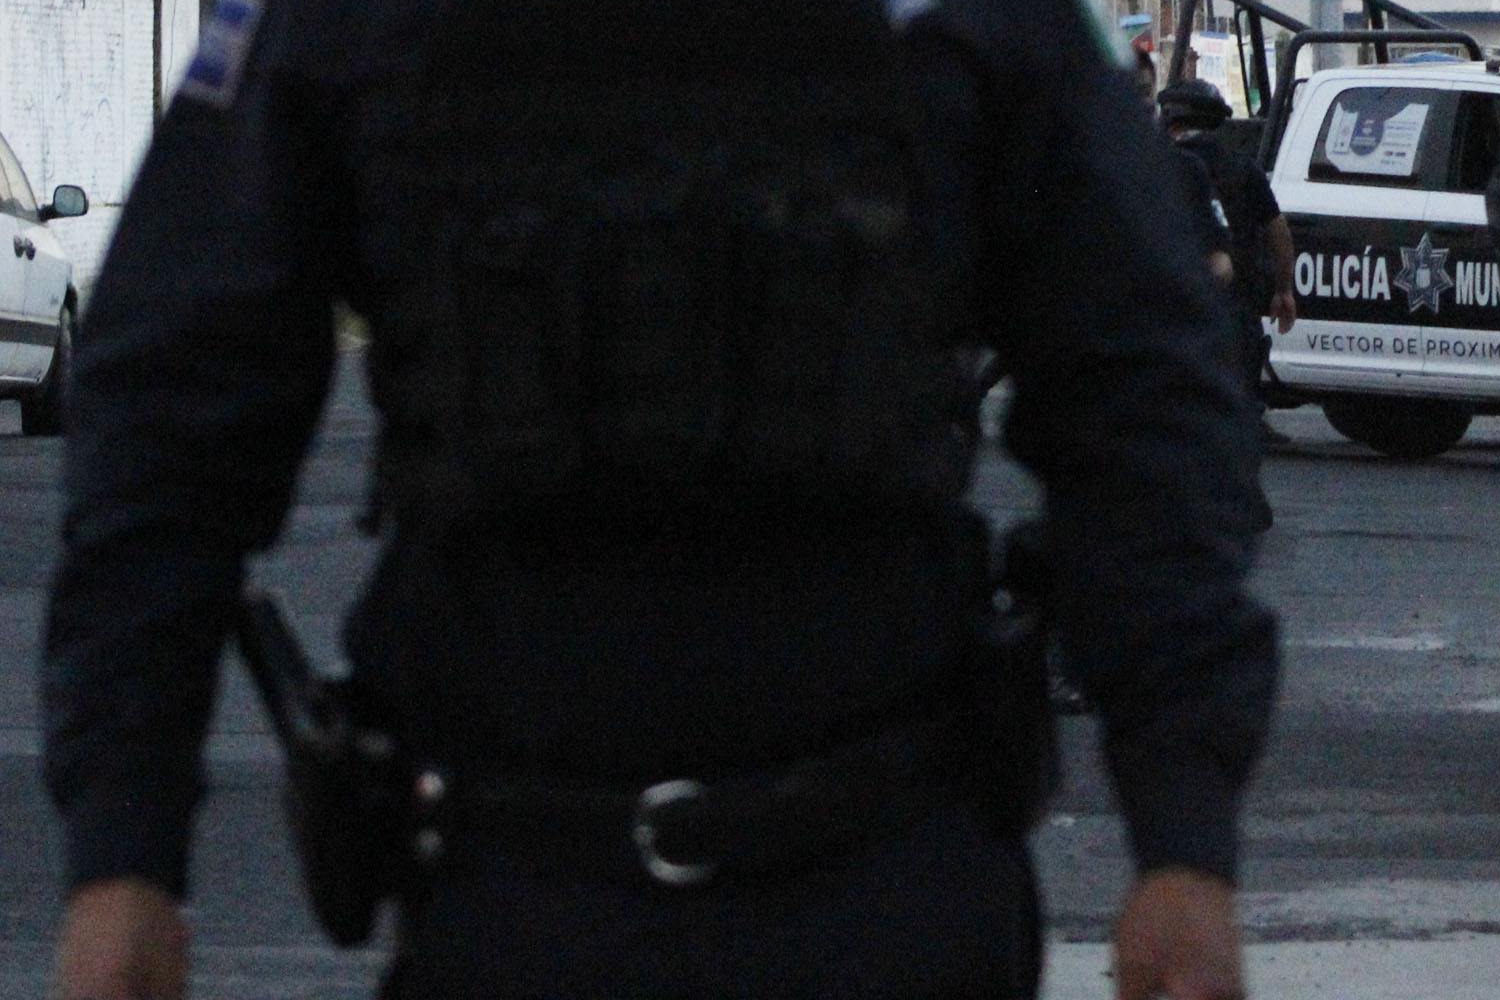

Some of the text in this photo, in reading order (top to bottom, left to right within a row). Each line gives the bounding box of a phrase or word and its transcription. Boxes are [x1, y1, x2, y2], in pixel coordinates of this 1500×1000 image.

[1294, 245, 1391, 300] OLICÍA
[1306, 333, 1384, 352] VECTOR
[1393, 337, 1417, 355] DE
